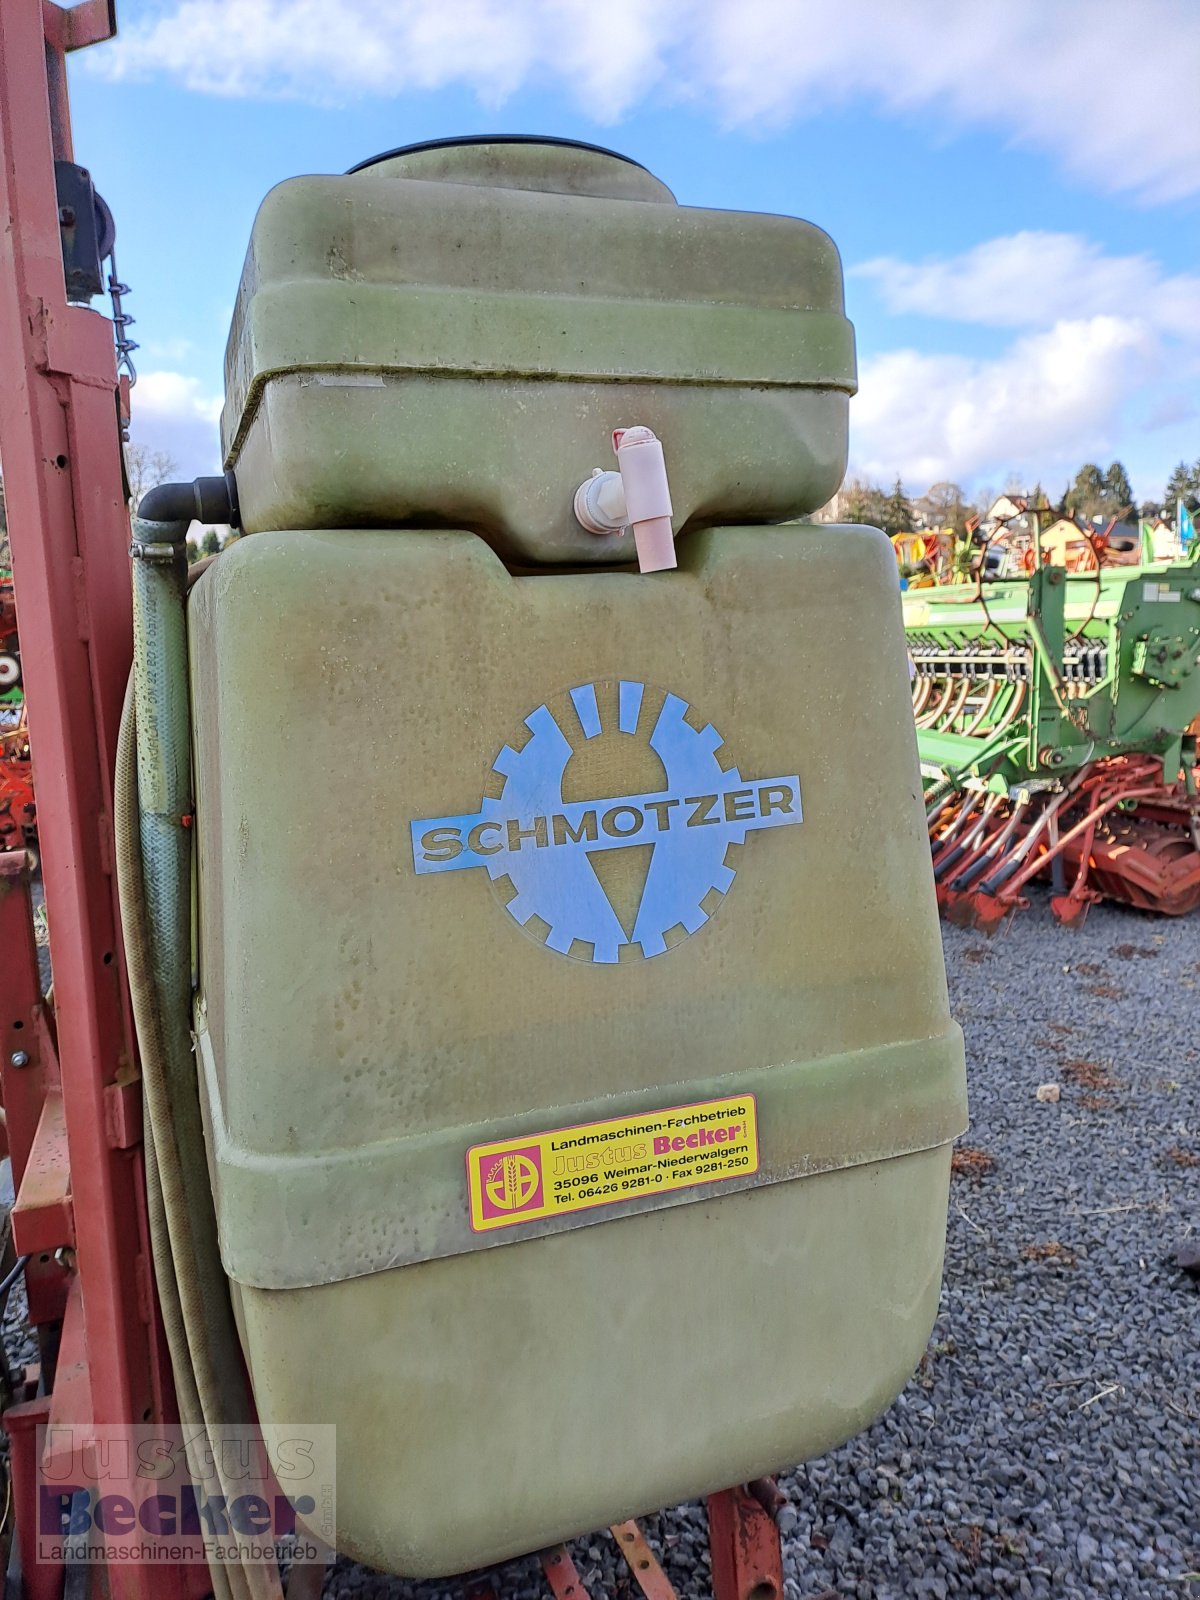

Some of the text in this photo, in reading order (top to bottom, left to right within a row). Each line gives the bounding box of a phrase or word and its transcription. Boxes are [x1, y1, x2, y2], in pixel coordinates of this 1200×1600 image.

[420, 784, 794, 862] SCHMOTZER
[551, 1106, 746, 1151] Landmaschinen-Fachbetrieb
[552, 1125, 741, 1176] Justus Becker
[553, 1146, 748, 1191] 35096 Weimar-Niederwalgern
[554, 1157, 749, 1204] Tel. 06426 9281-0 Fax 9281-250
